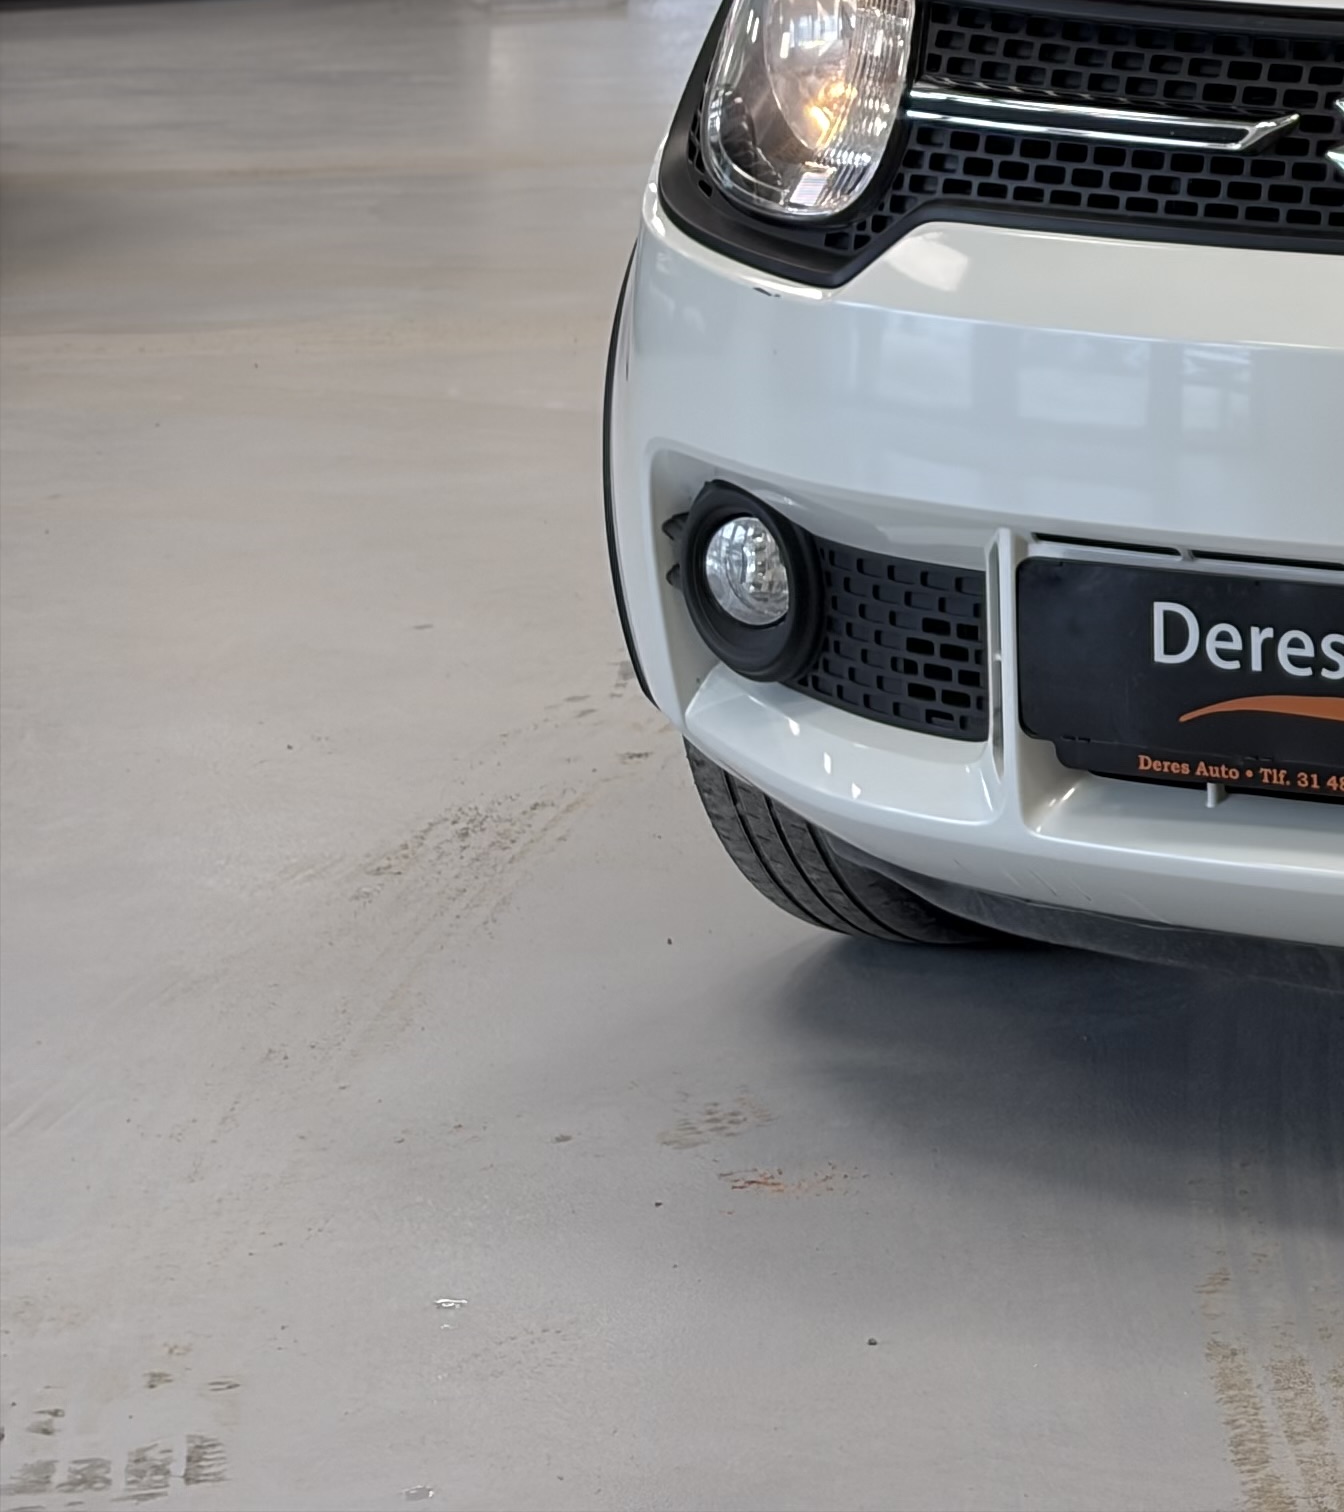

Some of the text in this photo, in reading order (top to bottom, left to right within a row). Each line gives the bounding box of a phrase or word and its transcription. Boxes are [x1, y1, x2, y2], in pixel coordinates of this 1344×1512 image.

[1137, 754, 1191, 776] Deres
[1195, 761, 1240, 780] Auto
[1260, 767, 1292, 786] Tlf.
[1296, 771, 1320, 791] 31
